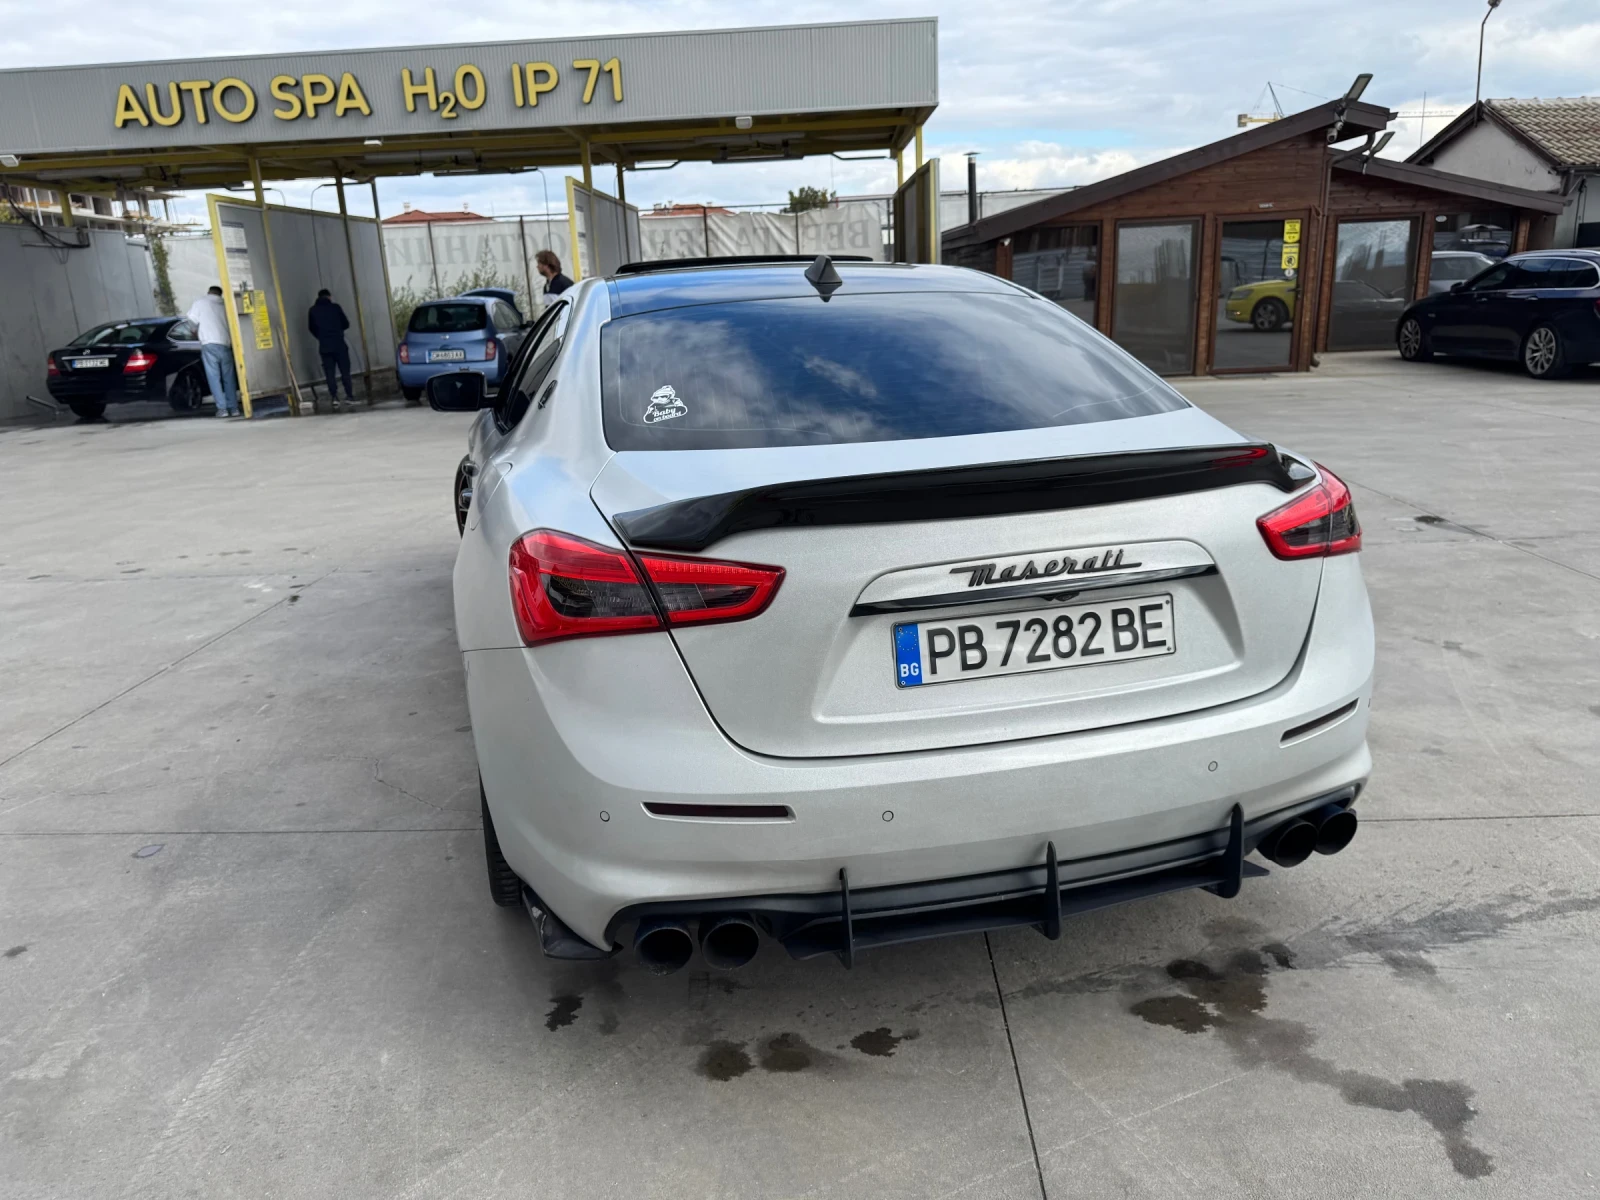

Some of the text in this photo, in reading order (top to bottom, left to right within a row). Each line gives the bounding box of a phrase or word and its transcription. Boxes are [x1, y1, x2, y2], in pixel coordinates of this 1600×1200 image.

[114, 77, 256, 129] AUTO
[270, 72, 372, 121] SPA
[512, 62, 560, 108] IP
[572, 56, 624, 104] 71
[950, 549, 1142, 587] Maserati
[927, 603, 1167, 675] PB 7282 BE
[900, 662, 919, 678] BG
